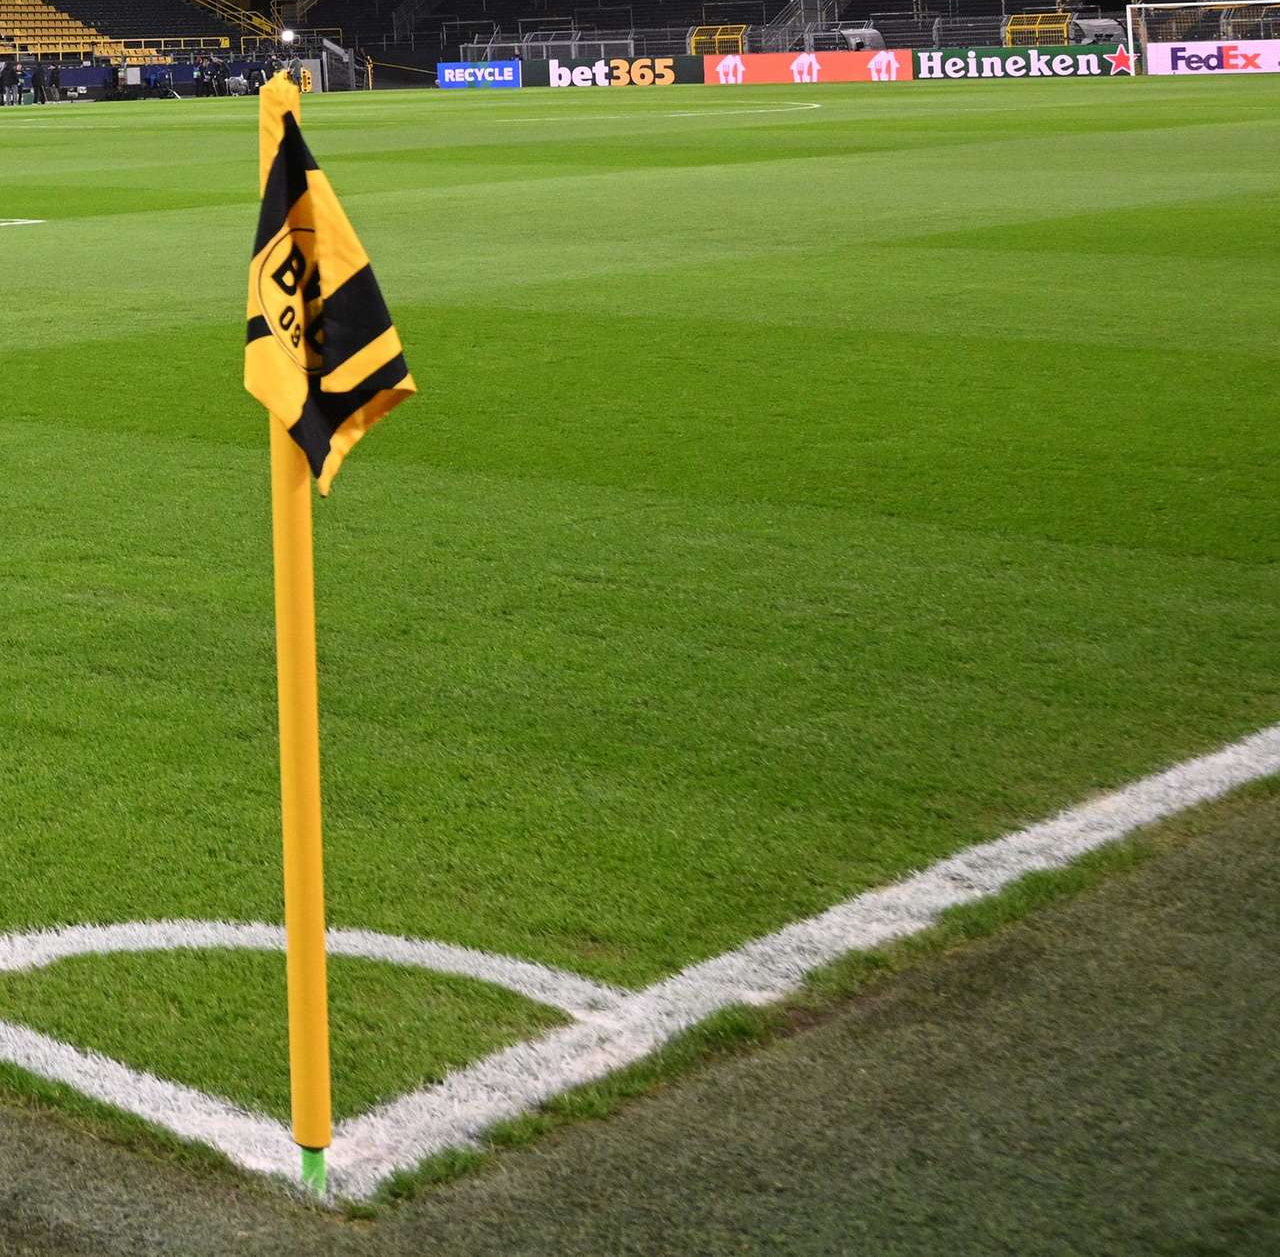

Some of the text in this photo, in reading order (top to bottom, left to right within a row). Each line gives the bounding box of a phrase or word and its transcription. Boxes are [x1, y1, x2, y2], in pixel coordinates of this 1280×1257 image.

[917, 49, 1101, 80] Heineken
[1170, 45, 1262, 71] FedEx
[444, 67, 513, 83] RECYCLE
[549, 57, 675, 88] bet365
